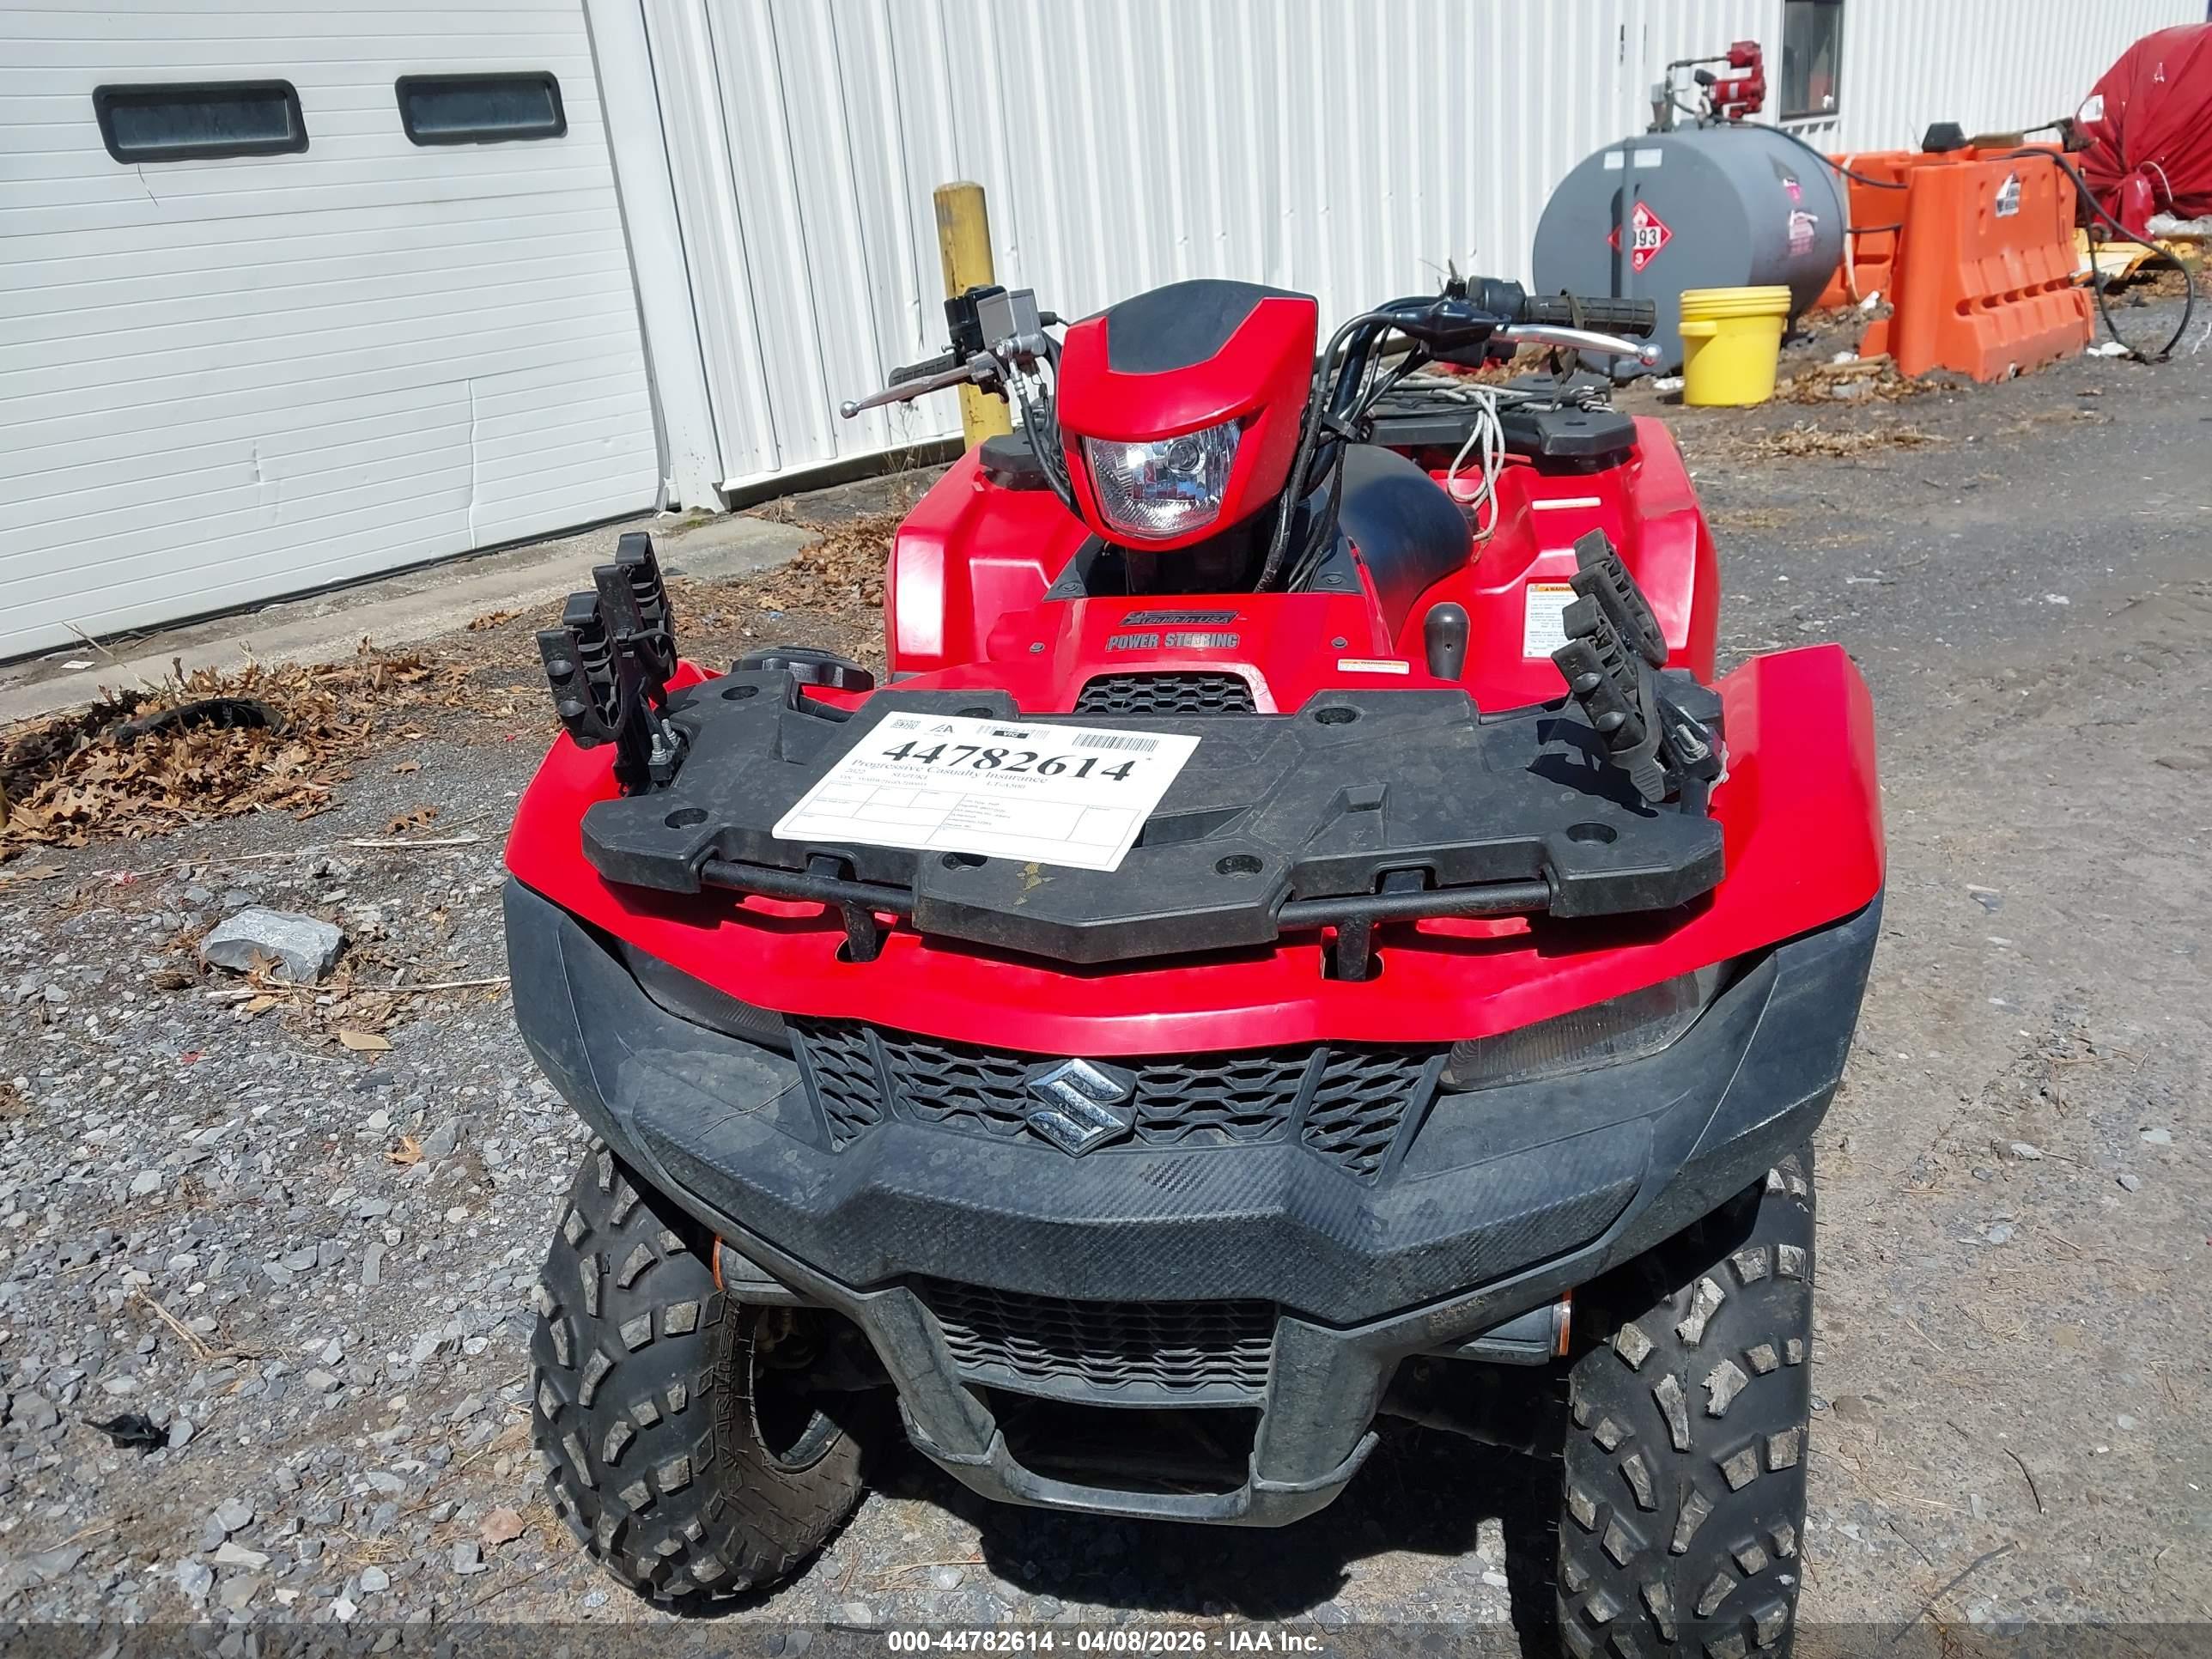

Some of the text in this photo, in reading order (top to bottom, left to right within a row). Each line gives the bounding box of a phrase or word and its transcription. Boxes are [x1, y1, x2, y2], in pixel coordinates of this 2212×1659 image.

[1635, 252, 1644, 264] 3
[1107, 633, 1239, 652] POWER STEERING
[851, 759, 1048, 783] Progressive Casualty Insurance
[882, 741, 1135, 781] 44782614
